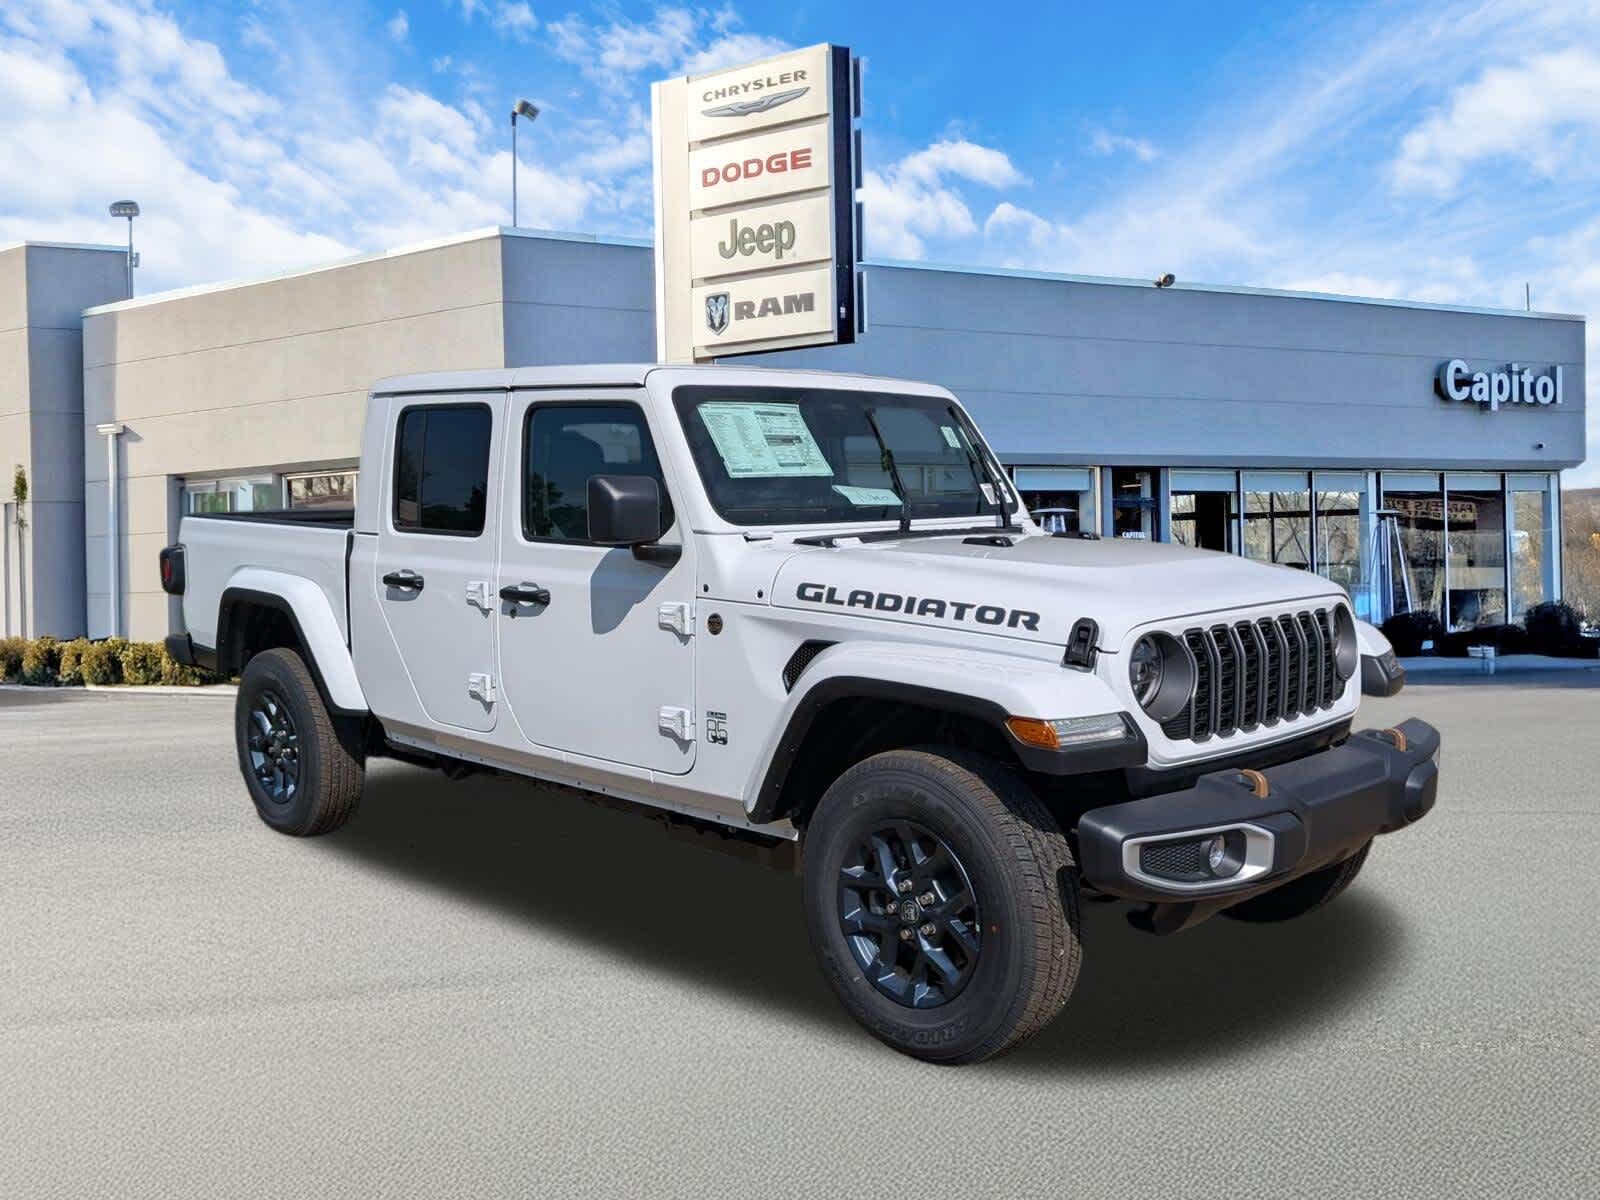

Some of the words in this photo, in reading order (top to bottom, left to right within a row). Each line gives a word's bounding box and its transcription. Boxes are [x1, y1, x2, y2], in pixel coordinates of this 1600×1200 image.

[702, 69, 808, 102] CHRYSLER
[702, 148, 813, 188] DODGE
[718, 218, 796, 259] Jeep
[734, 292, 815, 321] RAM
[1445, 359, 1563, 411] Capitol
[796, 582, 1041, 632] GLADIATOR
